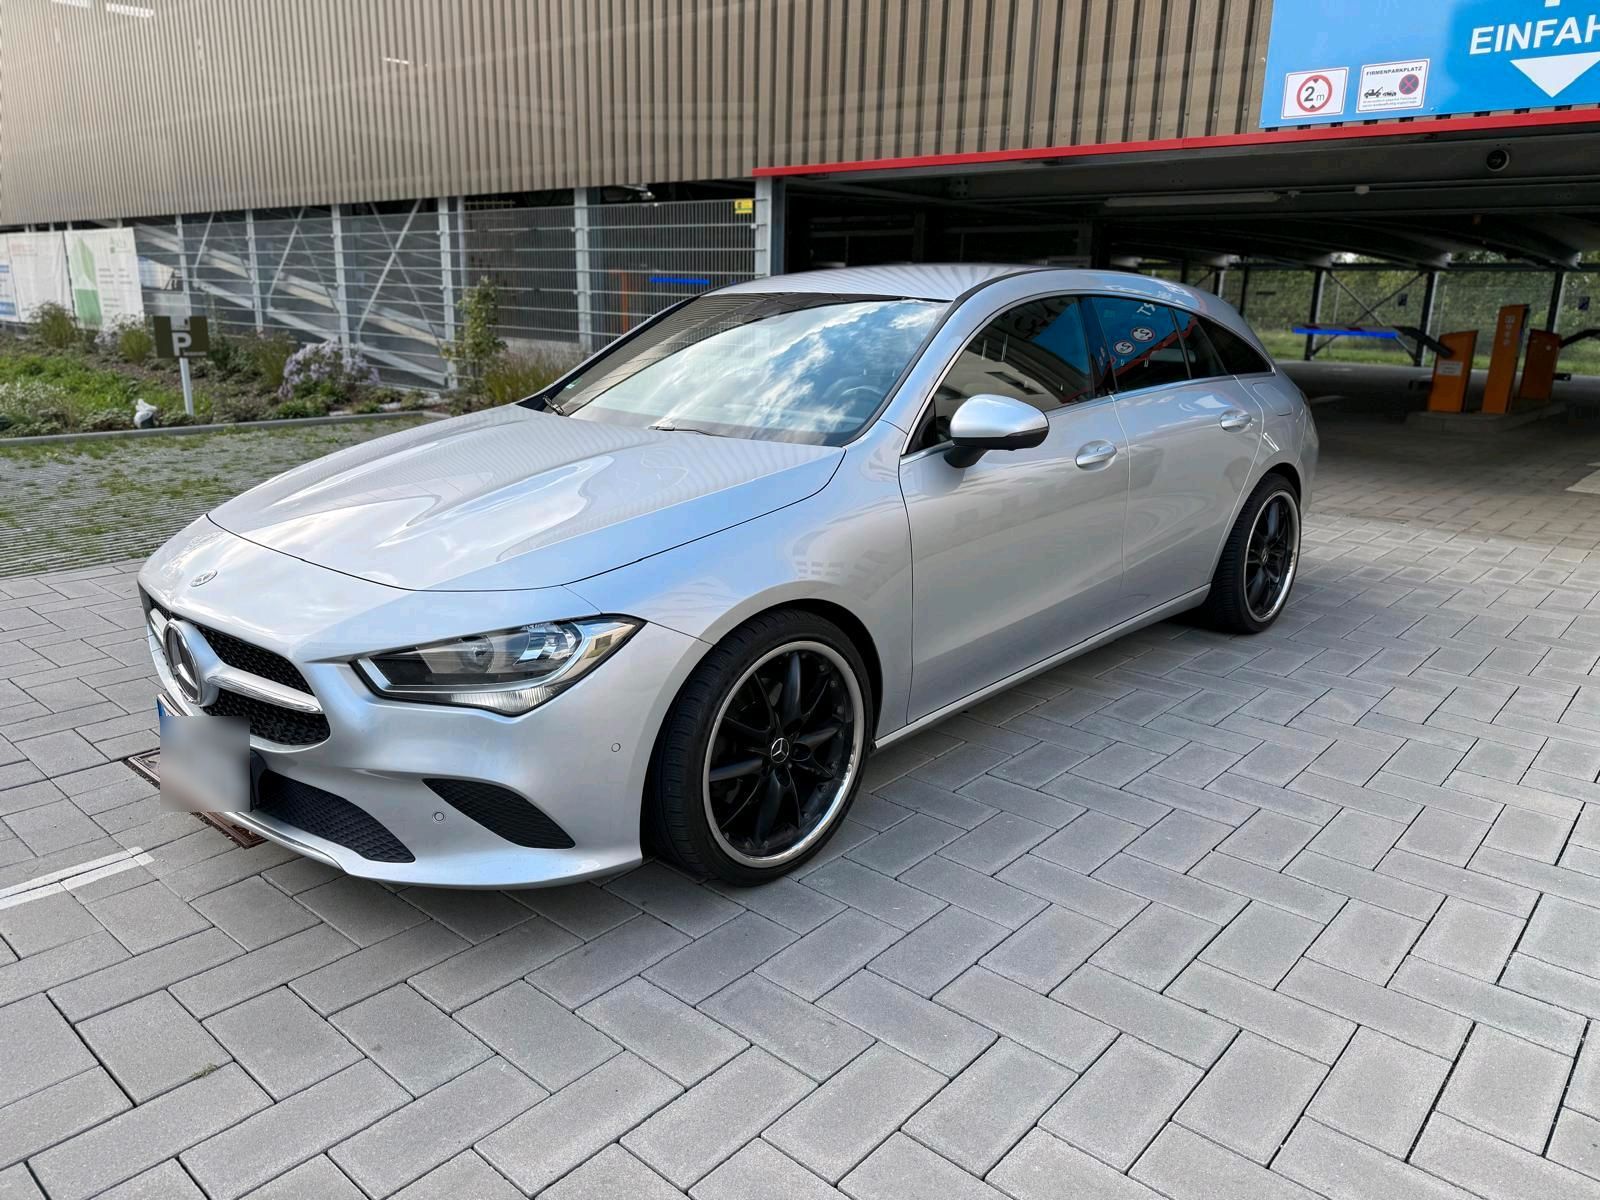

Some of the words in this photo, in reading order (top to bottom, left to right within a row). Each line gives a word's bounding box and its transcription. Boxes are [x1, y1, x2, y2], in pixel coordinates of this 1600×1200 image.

[1366, 65, 1423, 76] FIRMENPARKPLATZ
[1303, 86, 1315, 102] 2
[171, 331, 192, 357] P
